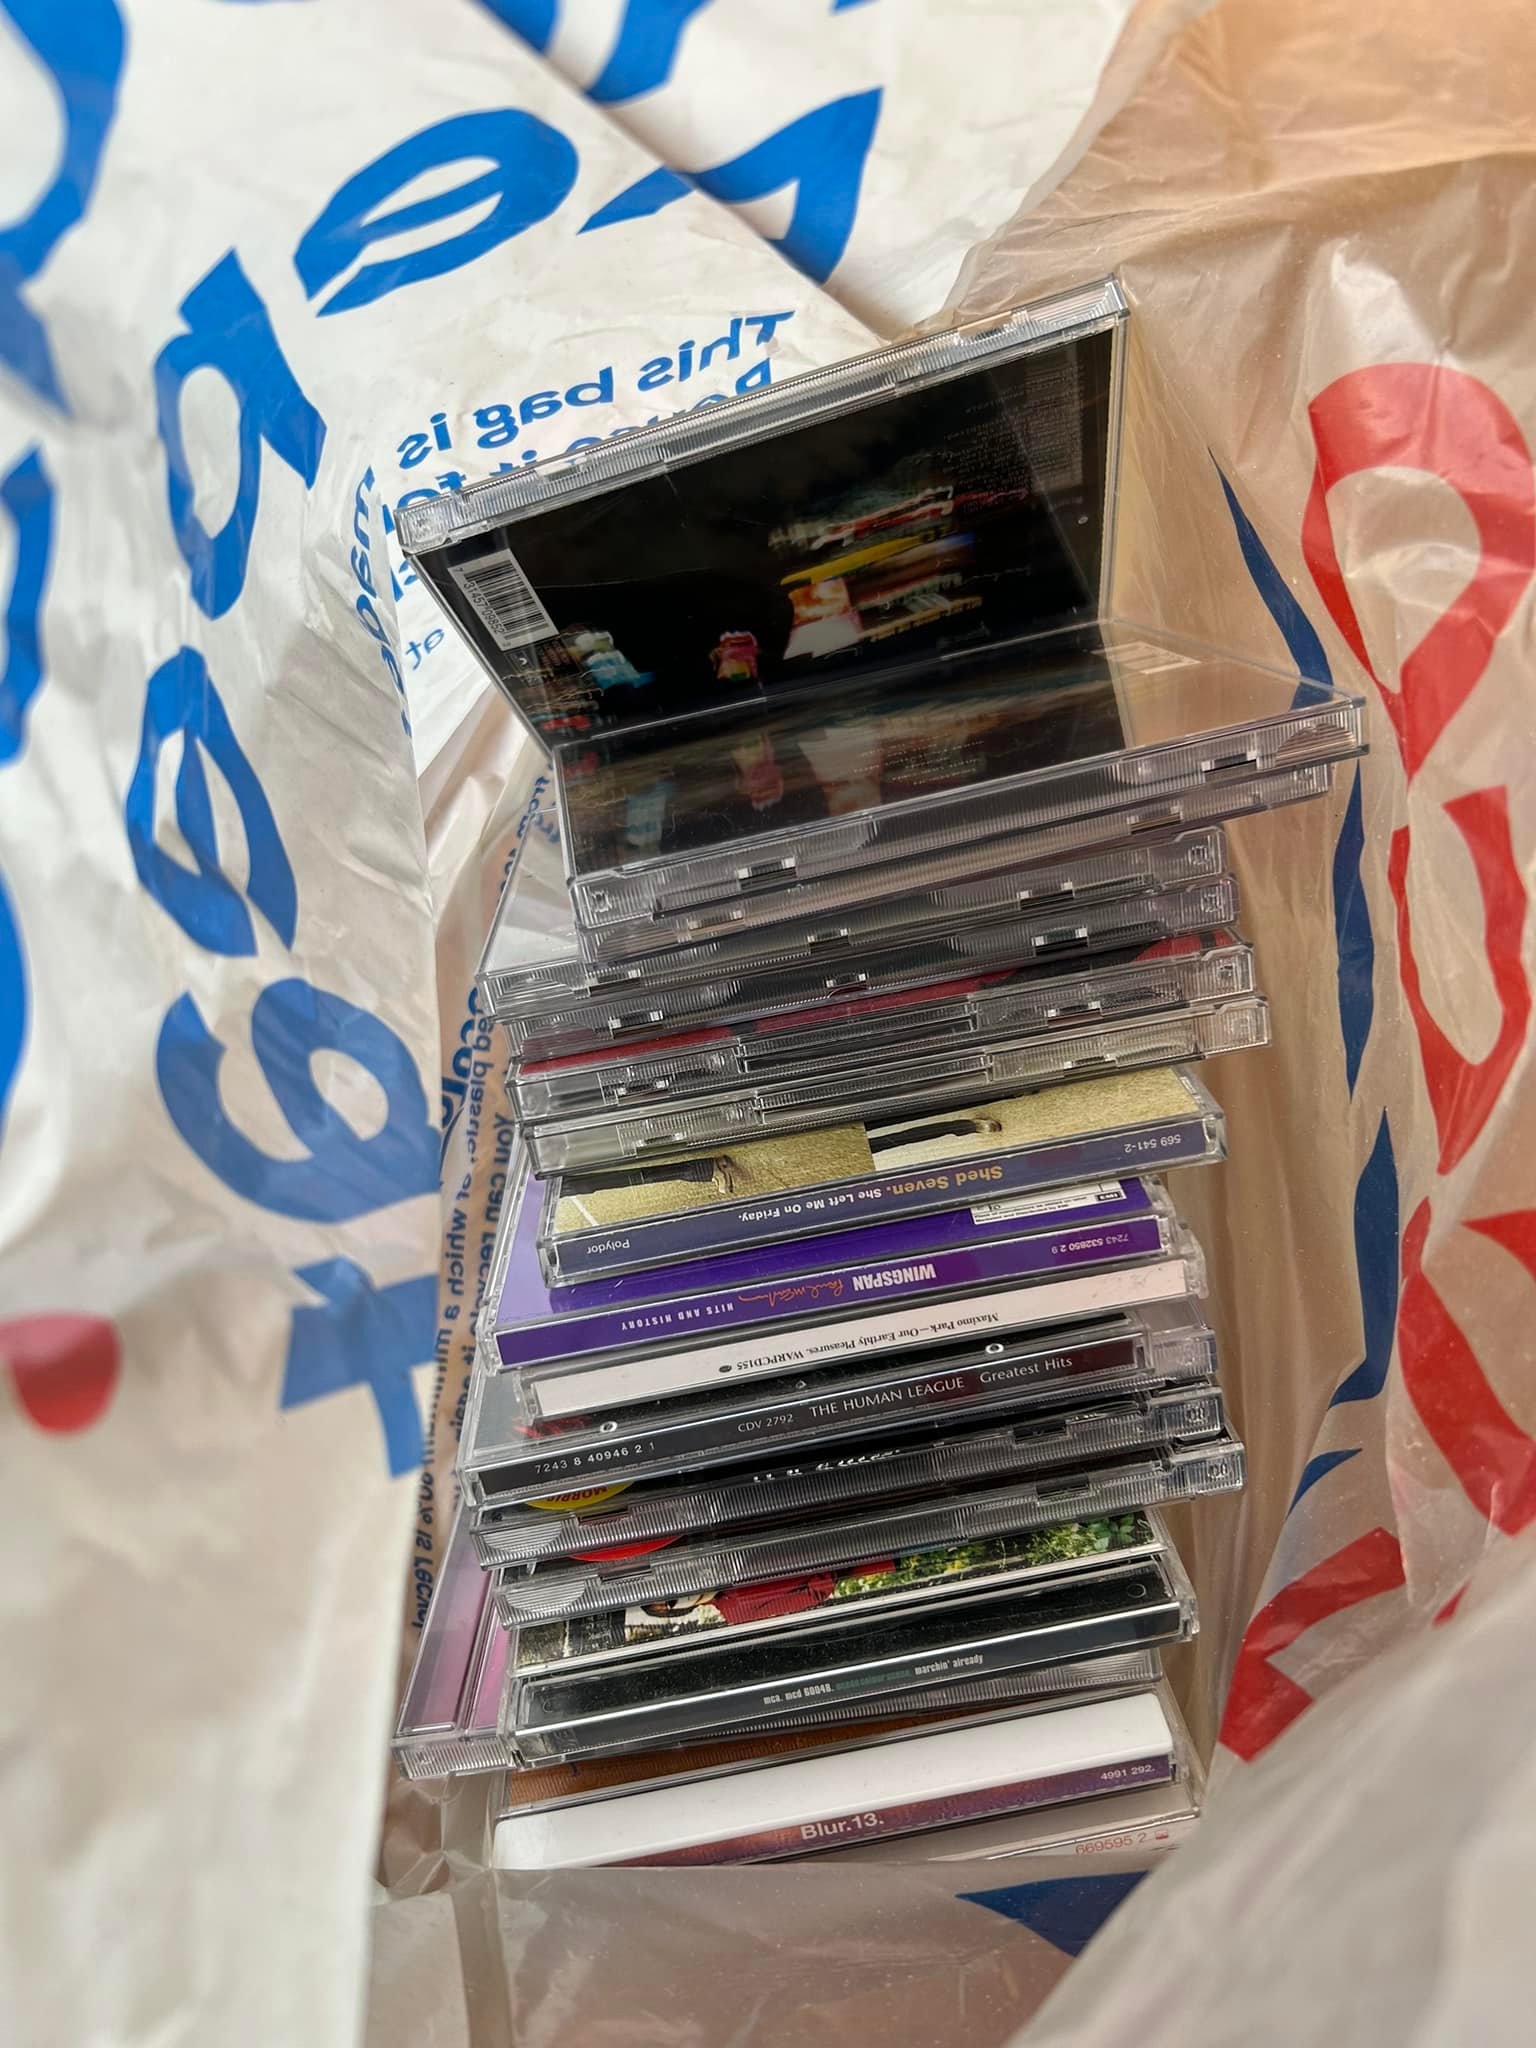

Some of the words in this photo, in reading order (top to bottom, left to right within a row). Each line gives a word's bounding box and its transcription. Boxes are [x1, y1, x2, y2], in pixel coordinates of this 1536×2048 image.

[1124, 1137, 1157, 1153] 541-2
[1160, 1133, 1182, 1147] 569
[955, 1165, 1003, 1186] Shed
[857, 1188, 882, 1199] She
[885, 1175, 950, 1196] Seven.
[805, 1198, 825, 1210] Me
[828, 1193, 854, 1207] Left
[738, 1207, 781, 1223] Friday.
[784, 1203, 802, 1215] On
[586, 1239, 631, 1255] Polydor
[1105, 1233, 1129, 1246] 7243
[1051, 1245, 1059, 1255] 9
[1059, 1244, 1068, 1253] 2
[852, 1263, 937, 1292] WINGSPAN
[678, 1307, 701, 1321] AND
[706, 1302, 734, 1316] HITS
[621, 1313, 674, 1331] HISTORY
[805, 1338, 856, 1354] Pleasures.
[857, 1330, 897, 1348] Earthly
[736, 1350, 804, 1371] WARPCD155
[534, 1460, 569, 1475] 7243
[573, 1456, 582, 1466] 8
[587, 1446, 629, 1463] 40946
[634, 1444, 643, 1454] 2
[737, 1419, 762, 1434] CDV
[766, 1413, 794, 1428] 2792
[809, 1402, 839, 1418] THE
[843, 1388, 903, 1412] HUMAN
[907, 1376, 966, 1400] LEAGUE
[979, 1362, 1040, 1384] Greatest
[1044, 1356, 1073, 1372] Hits
[763, 1694, 783, 1706] mca.
[785, 1689, 802, 1701] mcd
[914, 1659, 950, 1676] marchin'
[952, 1653, 984, 1669] already
[1100, 1768, 1128, 1782] 4991
